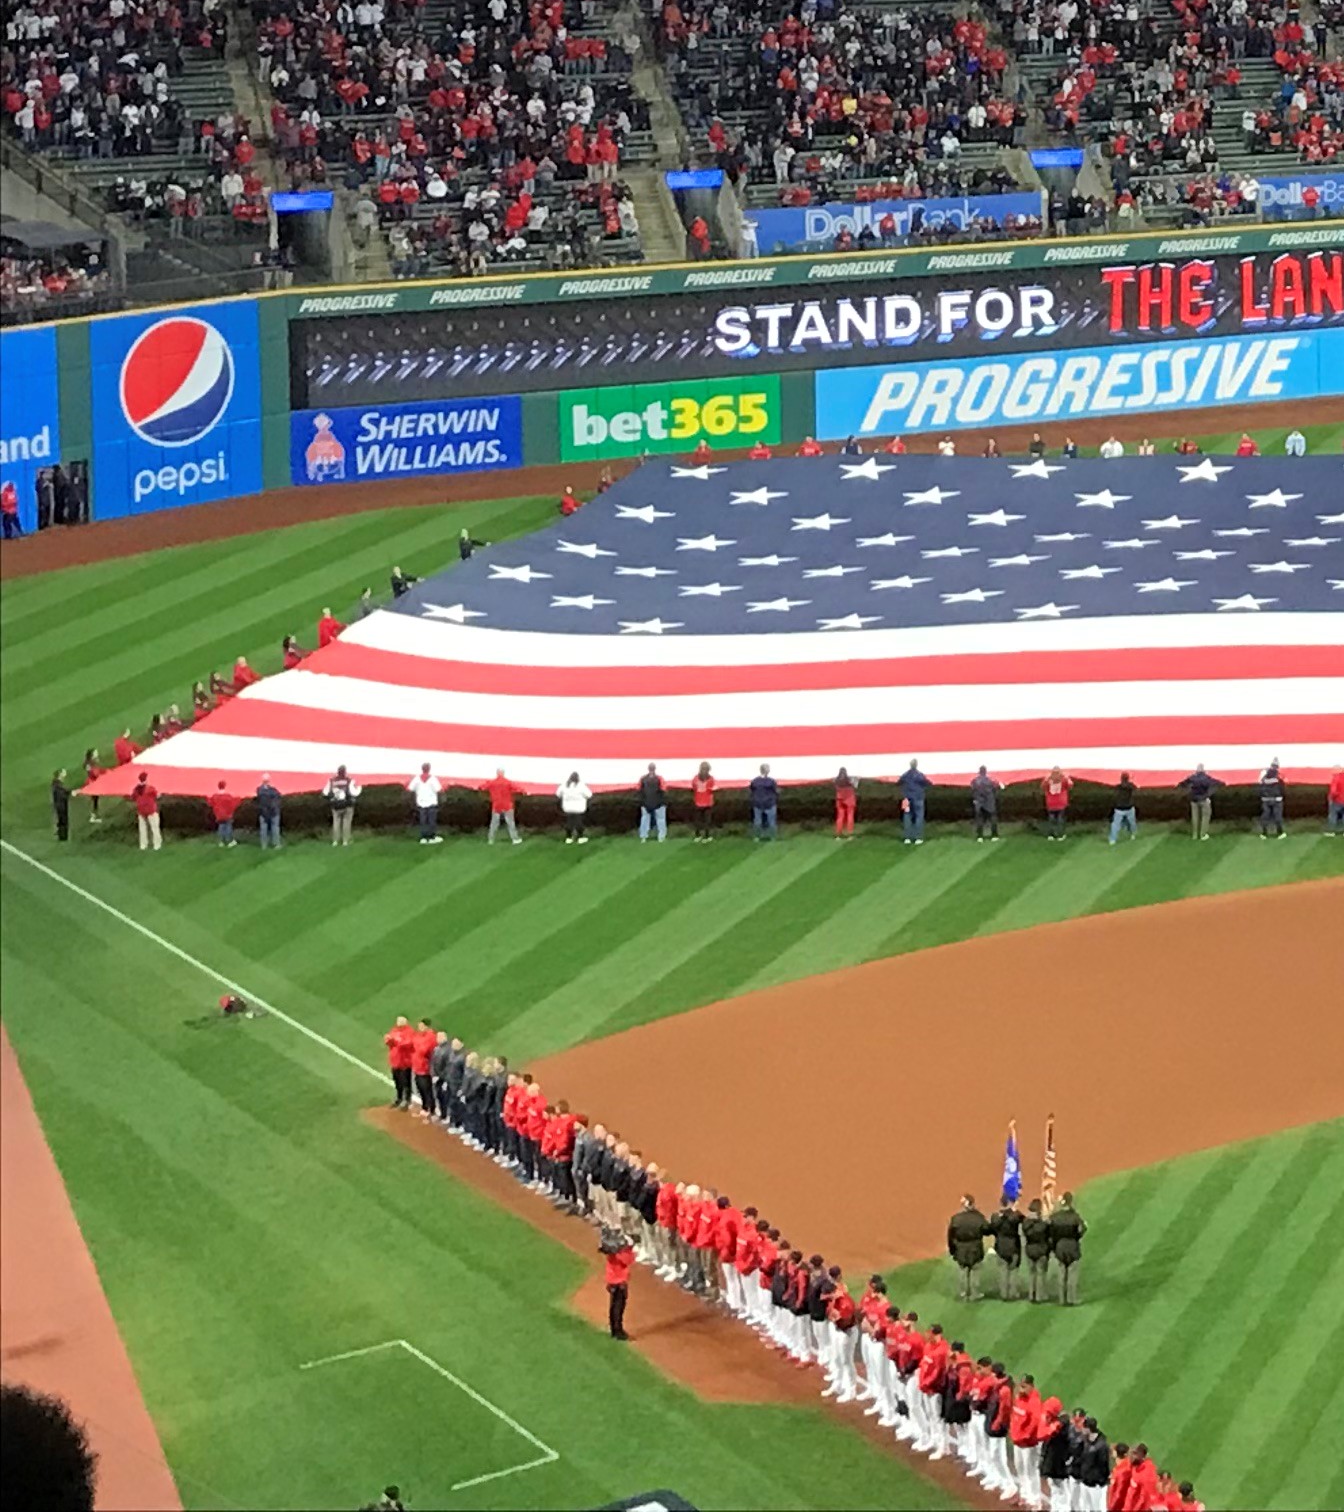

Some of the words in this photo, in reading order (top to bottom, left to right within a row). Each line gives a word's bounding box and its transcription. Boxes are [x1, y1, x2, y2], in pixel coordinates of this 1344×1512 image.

[300, 293, 398, 313] PROGRESSIVE
[429, 285, 526, 305] PROGRESSIVE
[558, 275, 653, 296] PROGRESSIVE
[684, 267, 777, 287] PROGRESSIVE
[808, 259, 898, 279] PROGRESSIVE
[927, 251, 1015, 270] PROGRESSIVE
[1044, 243, 1129, 261] PROGRESSIVE
[1159, 235, 1239, 253] PROGRESSIVE
[715, 294, 922, 353] STAND
[937, 286, 1058, 336] FOR
[1102, 260, 1214, 335] THE
[860, 338, 1299, 432] PROGRESSIVE
[357, 407, 500, 442] SHERWIN
[573, 393, 768, 446] bet365
[135, 451, 227, 503] pepsi
